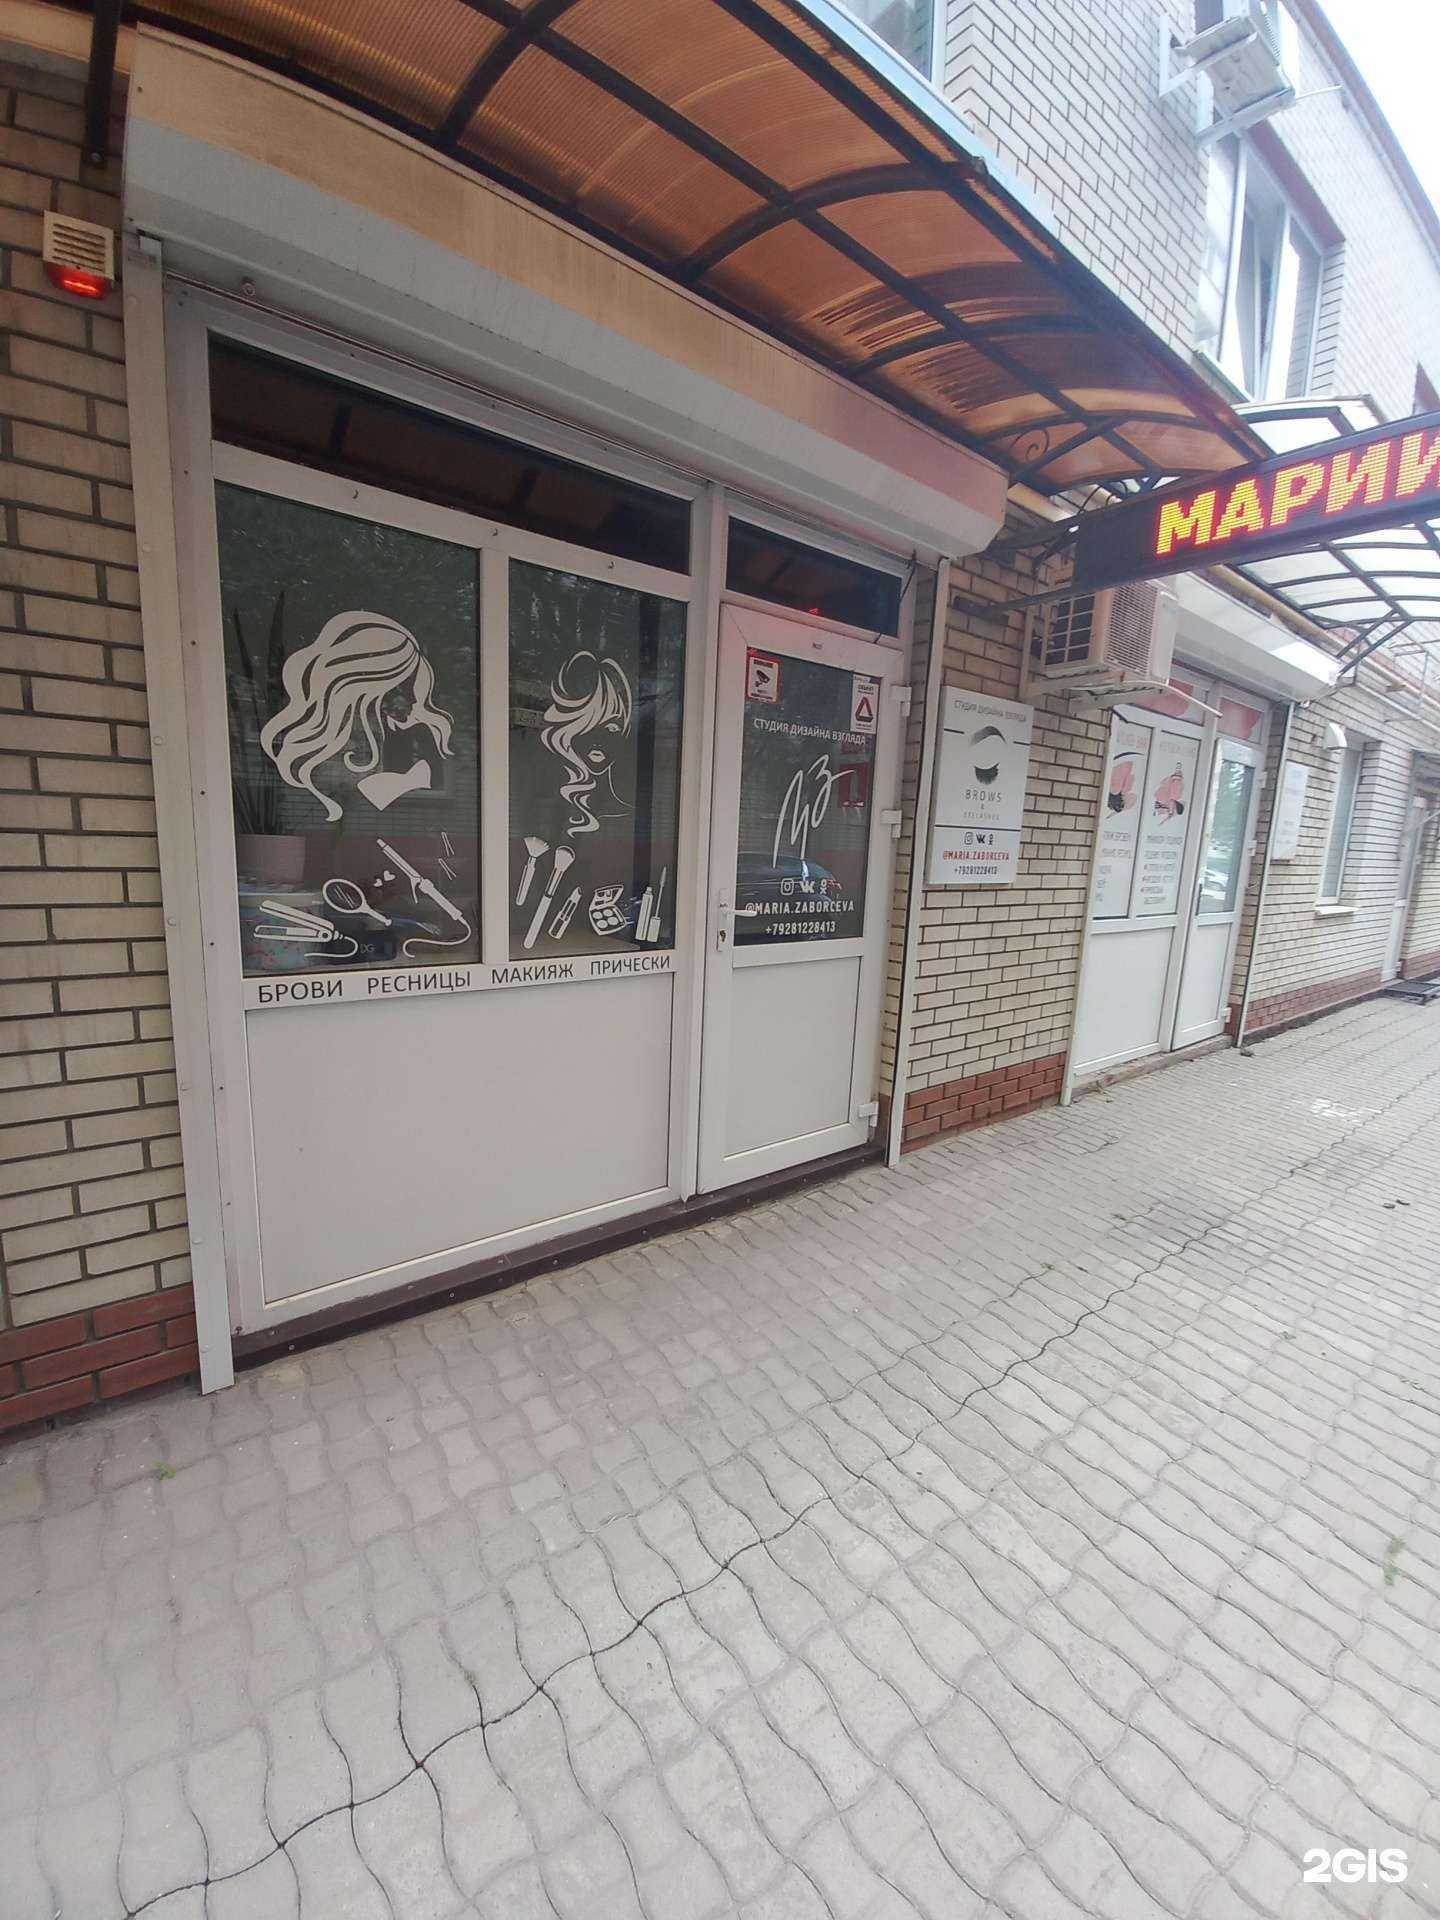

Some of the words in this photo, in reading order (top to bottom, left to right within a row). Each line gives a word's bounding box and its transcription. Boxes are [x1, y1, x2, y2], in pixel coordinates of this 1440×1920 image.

[753, 718, 789, 733] СТУДИЯ
[788, 723, 831, 739] ДИЗАЙНА
[832, 730, 867, 745] ВЗГЛЯДА
[965, 789, 1002, 803] BROWS
[954, 865, 998, 875] +79281228413
[765, 921, 836, 936] +79281228413
[258, 979, 344, 1004] БРОВИ
[367, 970, 471, 995] РЕСНИЦЫ
[491, 962, 575, 985] МАКИЯЖ
[589, 955, 671, 976] ПРИЧЕСКИ
